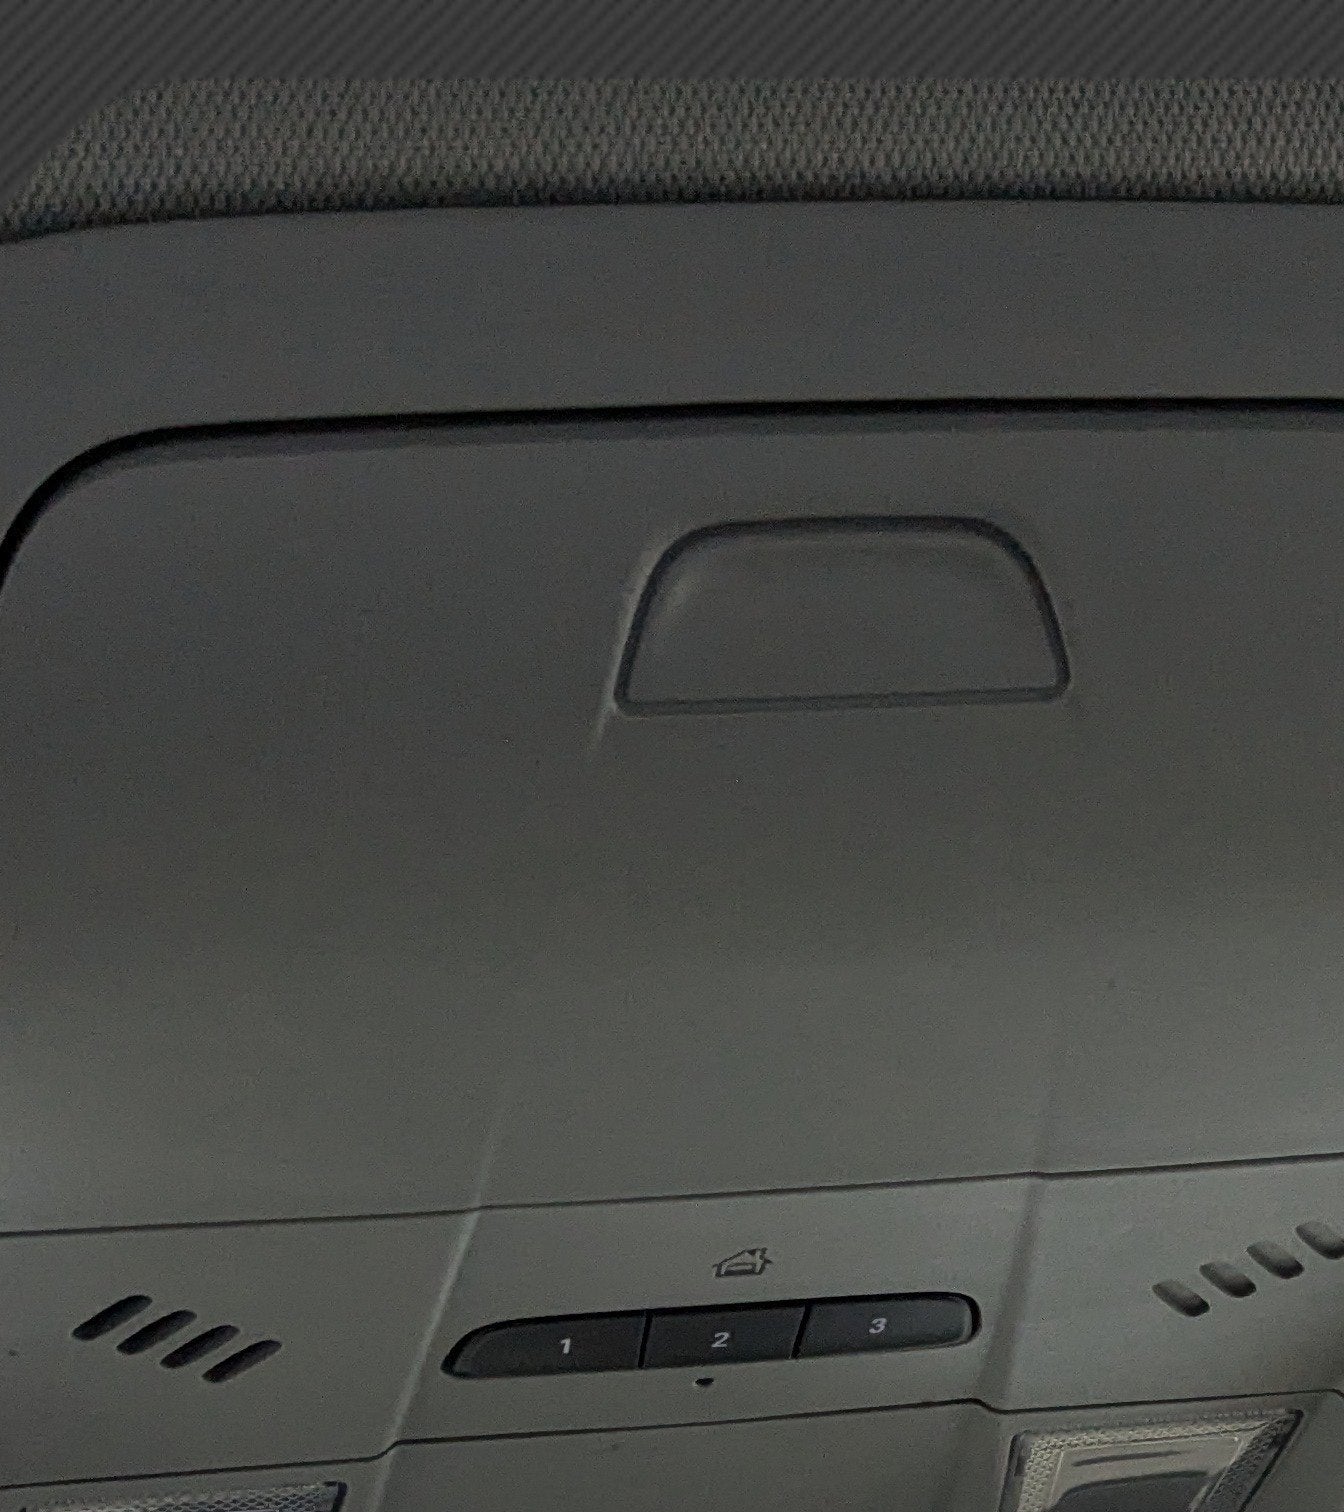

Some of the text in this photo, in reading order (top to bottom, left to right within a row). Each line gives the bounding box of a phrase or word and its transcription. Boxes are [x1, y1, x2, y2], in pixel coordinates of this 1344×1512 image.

[560, 1317, 888, 1355] 1 2 3
